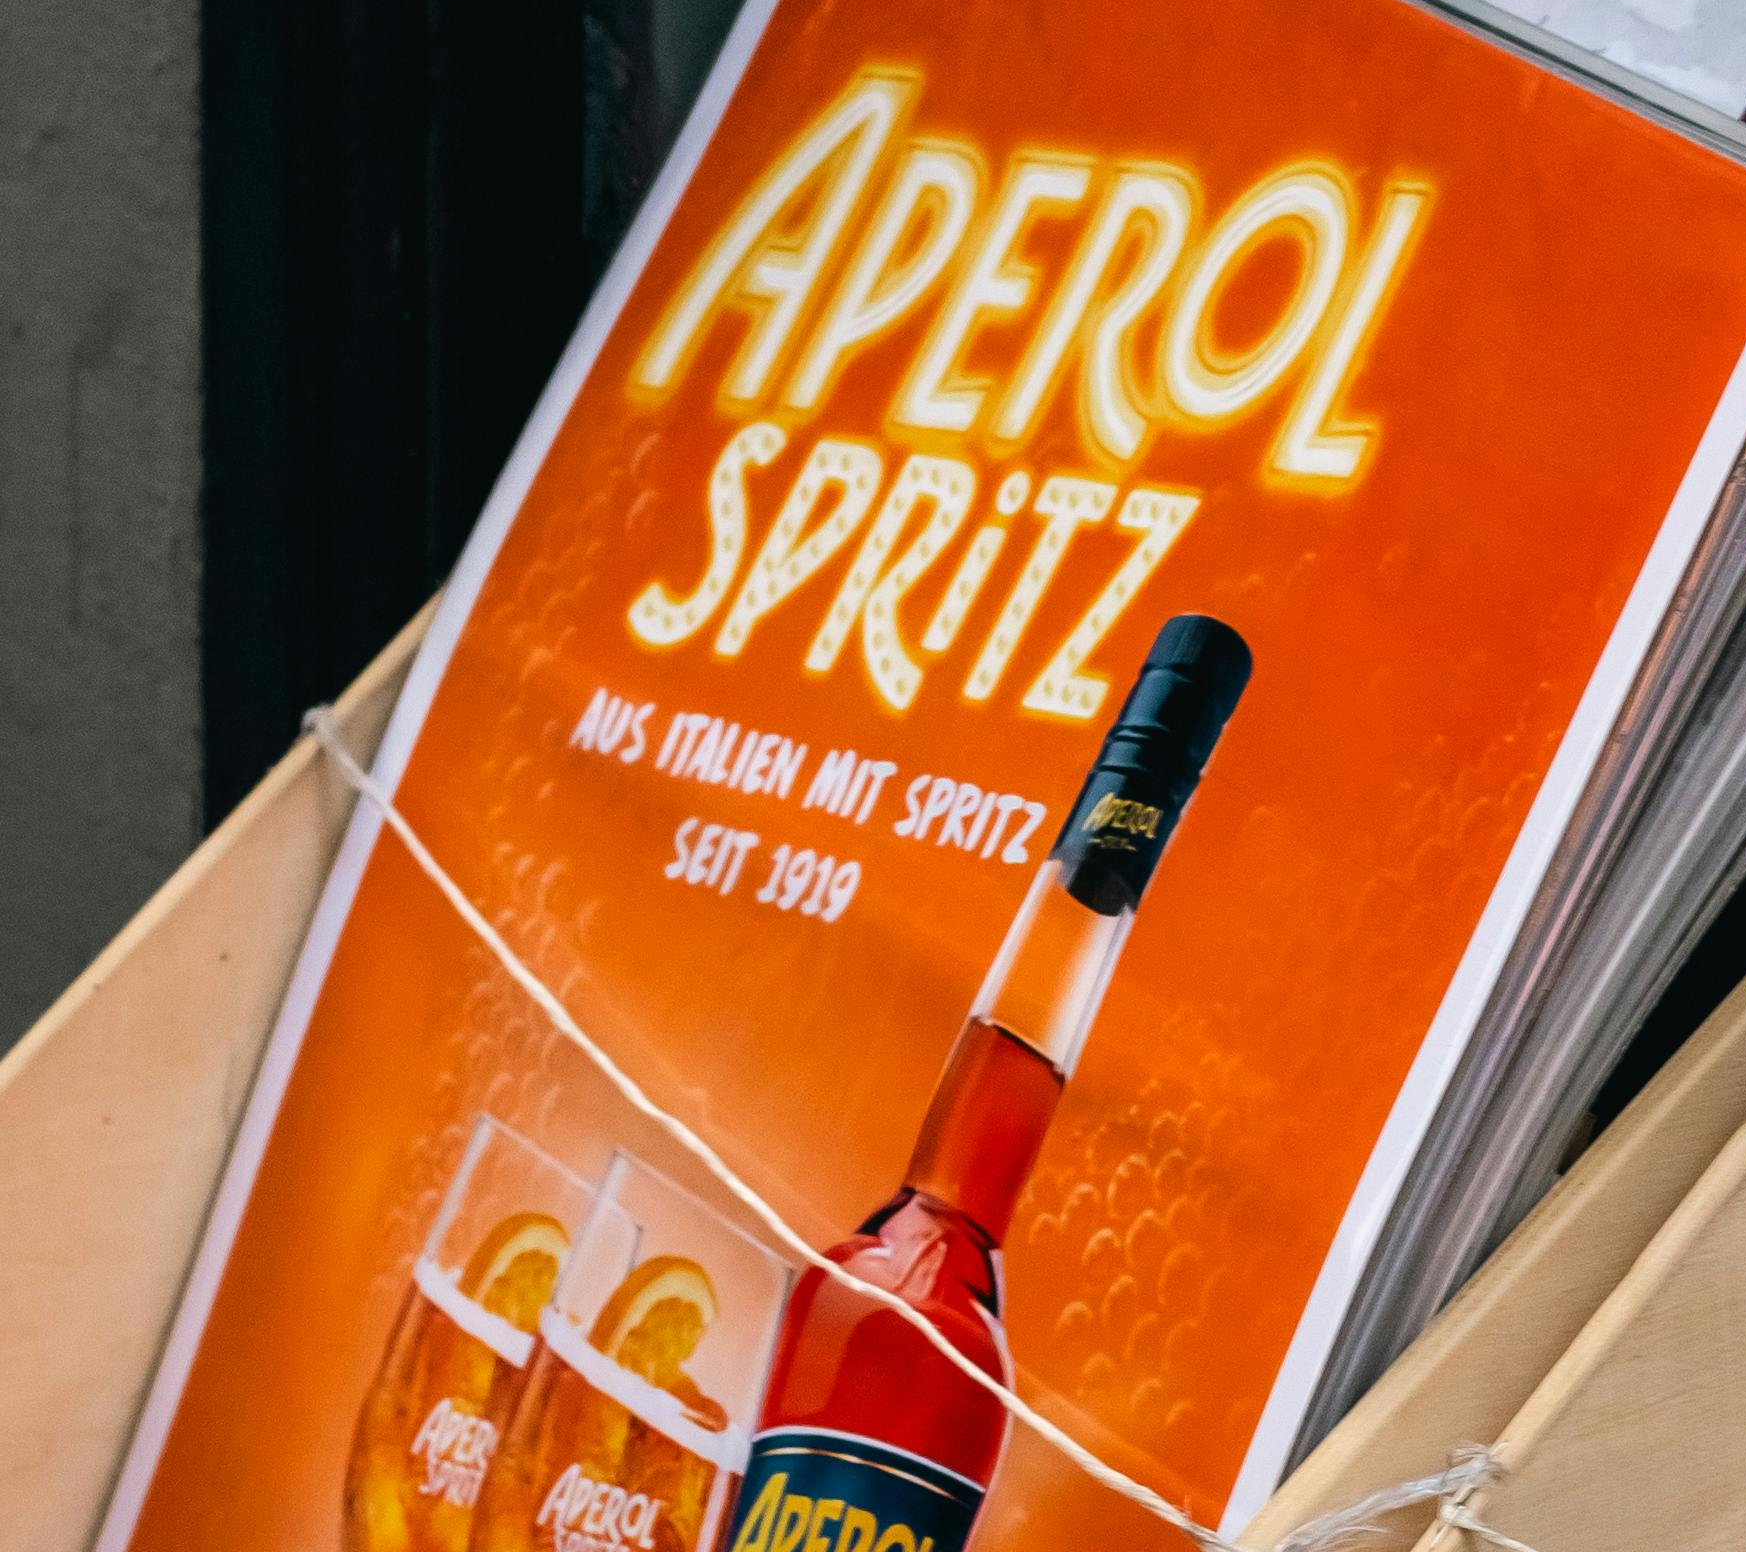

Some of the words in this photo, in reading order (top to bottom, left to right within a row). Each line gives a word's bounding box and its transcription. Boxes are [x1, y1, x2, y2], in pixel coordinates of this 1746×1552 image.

[628, 62, 1434, 488] APEROL
[569, 687, 656, 764] AUS
[655, 711, 809, 800] ITALIEN
[802, 748, 898, 826] MIT
[893, 773, 1047, 865] SPRITZ
[1082, 792, 1164, 840] APEROL
[663, 816, 760, 897] SEIT
[756, 843, 862, 924] 1919
[535, 1462, 662, 1549] APEROL
